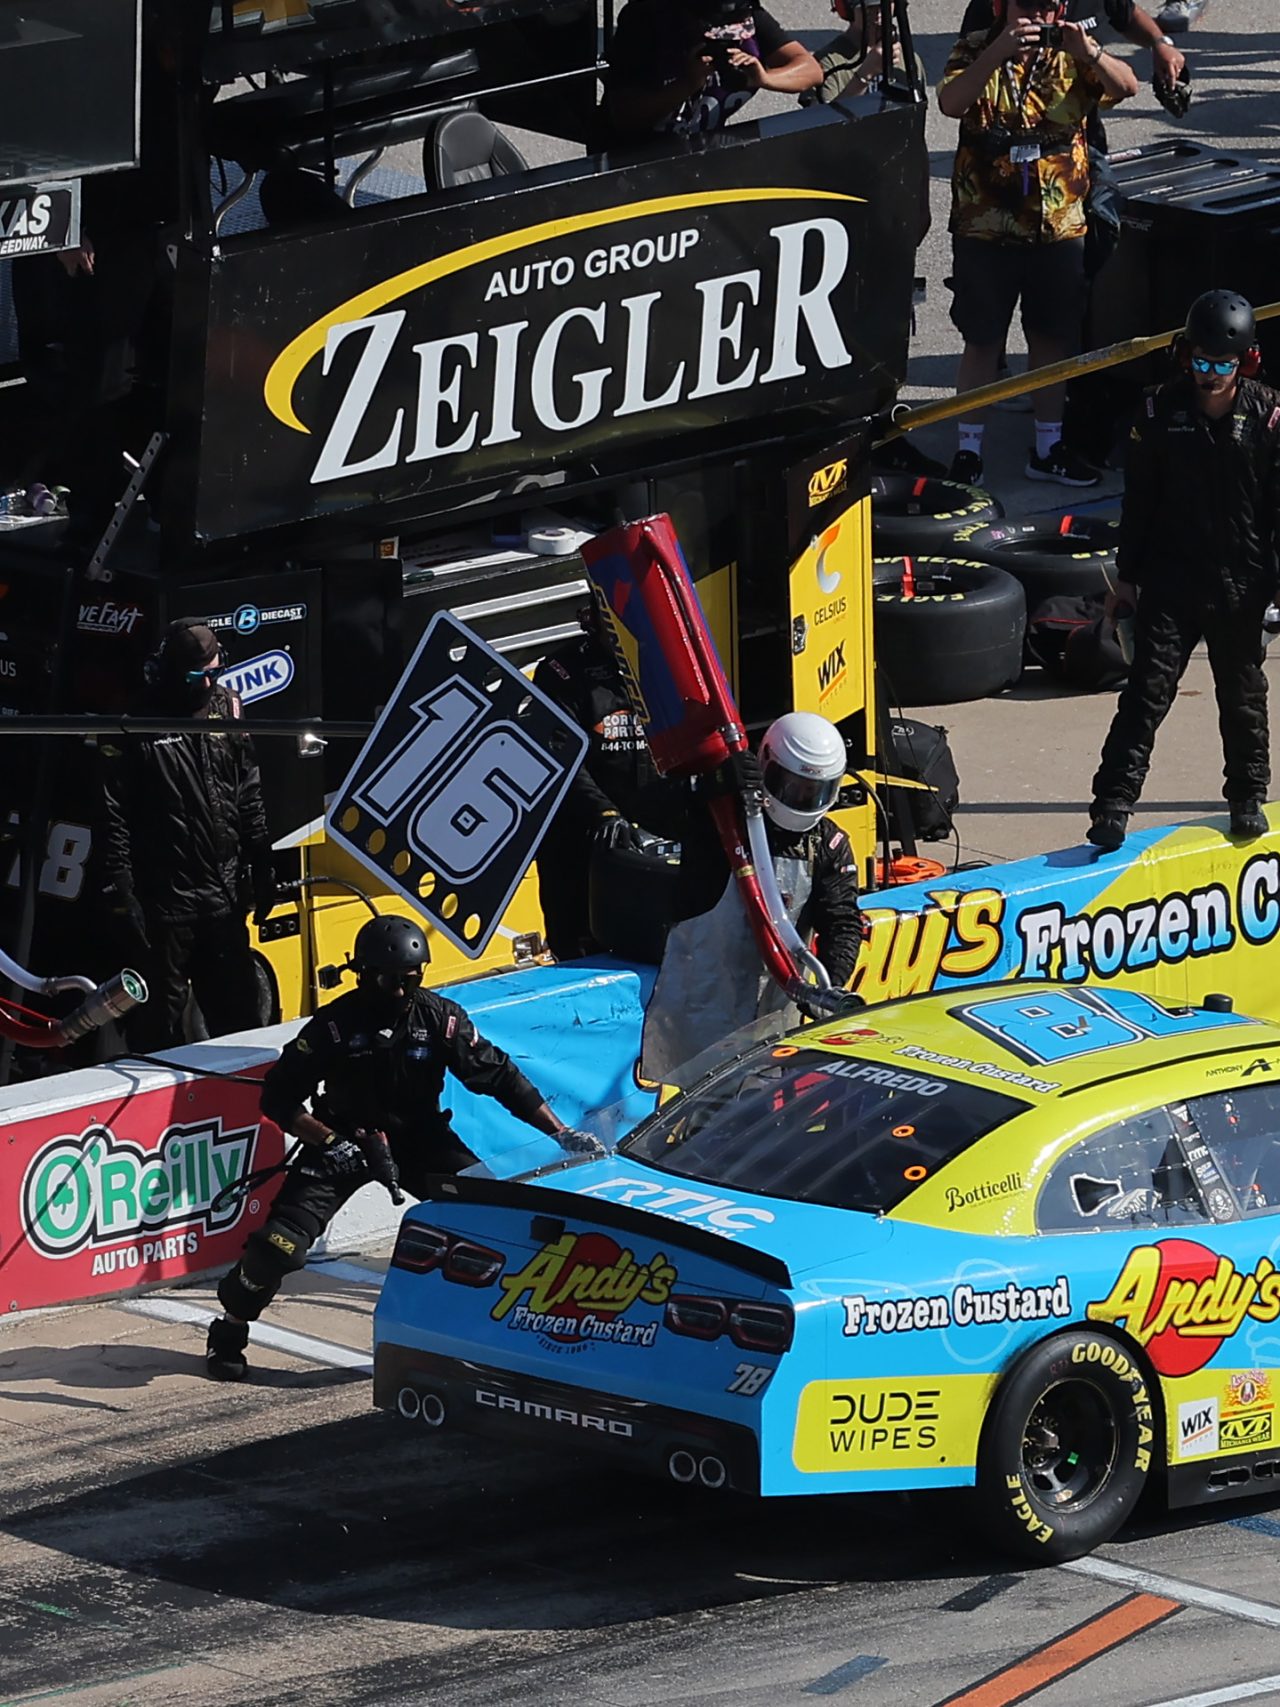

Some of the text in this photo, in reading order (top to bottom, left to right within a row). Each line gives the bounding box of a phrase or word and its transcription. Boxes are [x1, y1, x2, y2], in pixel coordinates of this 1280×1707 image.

[0, 235, 47, 255] EEDWAY
[485, 228, 700, 301] AUTO GROUP
[309, 216, 853, 484] ZEIGLER
[814, 597, 847, 626] CELSIUS
[225, 660, 283, 694] UNK
[817, 639, 847, 692] WIX
[353, 675, 563, 883] 16
[1018, 883, 1231, 982] Frozen
[816, 1060, 948, 1096] ALFREDO
[893, 1045, 1062, 1092] Frozen Custard
[37, 1136, 242, 1241] O'Reilly
[578, 1176, 776, 1230] RTIC
[945, 1171, 1022, 1212] Botticelli
[92, 1231, 198, 1276] AUTO PARTS
[489, 1232, 679, 1321] Andy's
[509, 1305, 659, 1347] Frozen Custard
[842, 1275, 1071, 1336] Frozen Custard
[726, 1362, 773, 1396] 78
[475, 1388, 633, 1438] CAMARO
[829, 1390, 941, 1425] DUDE
[1181, 1406, 1213, 1438] WIX
[829, 1425, 938, 1453] WIPES
[1005, 1472, 1055, 1545] EAGLE
